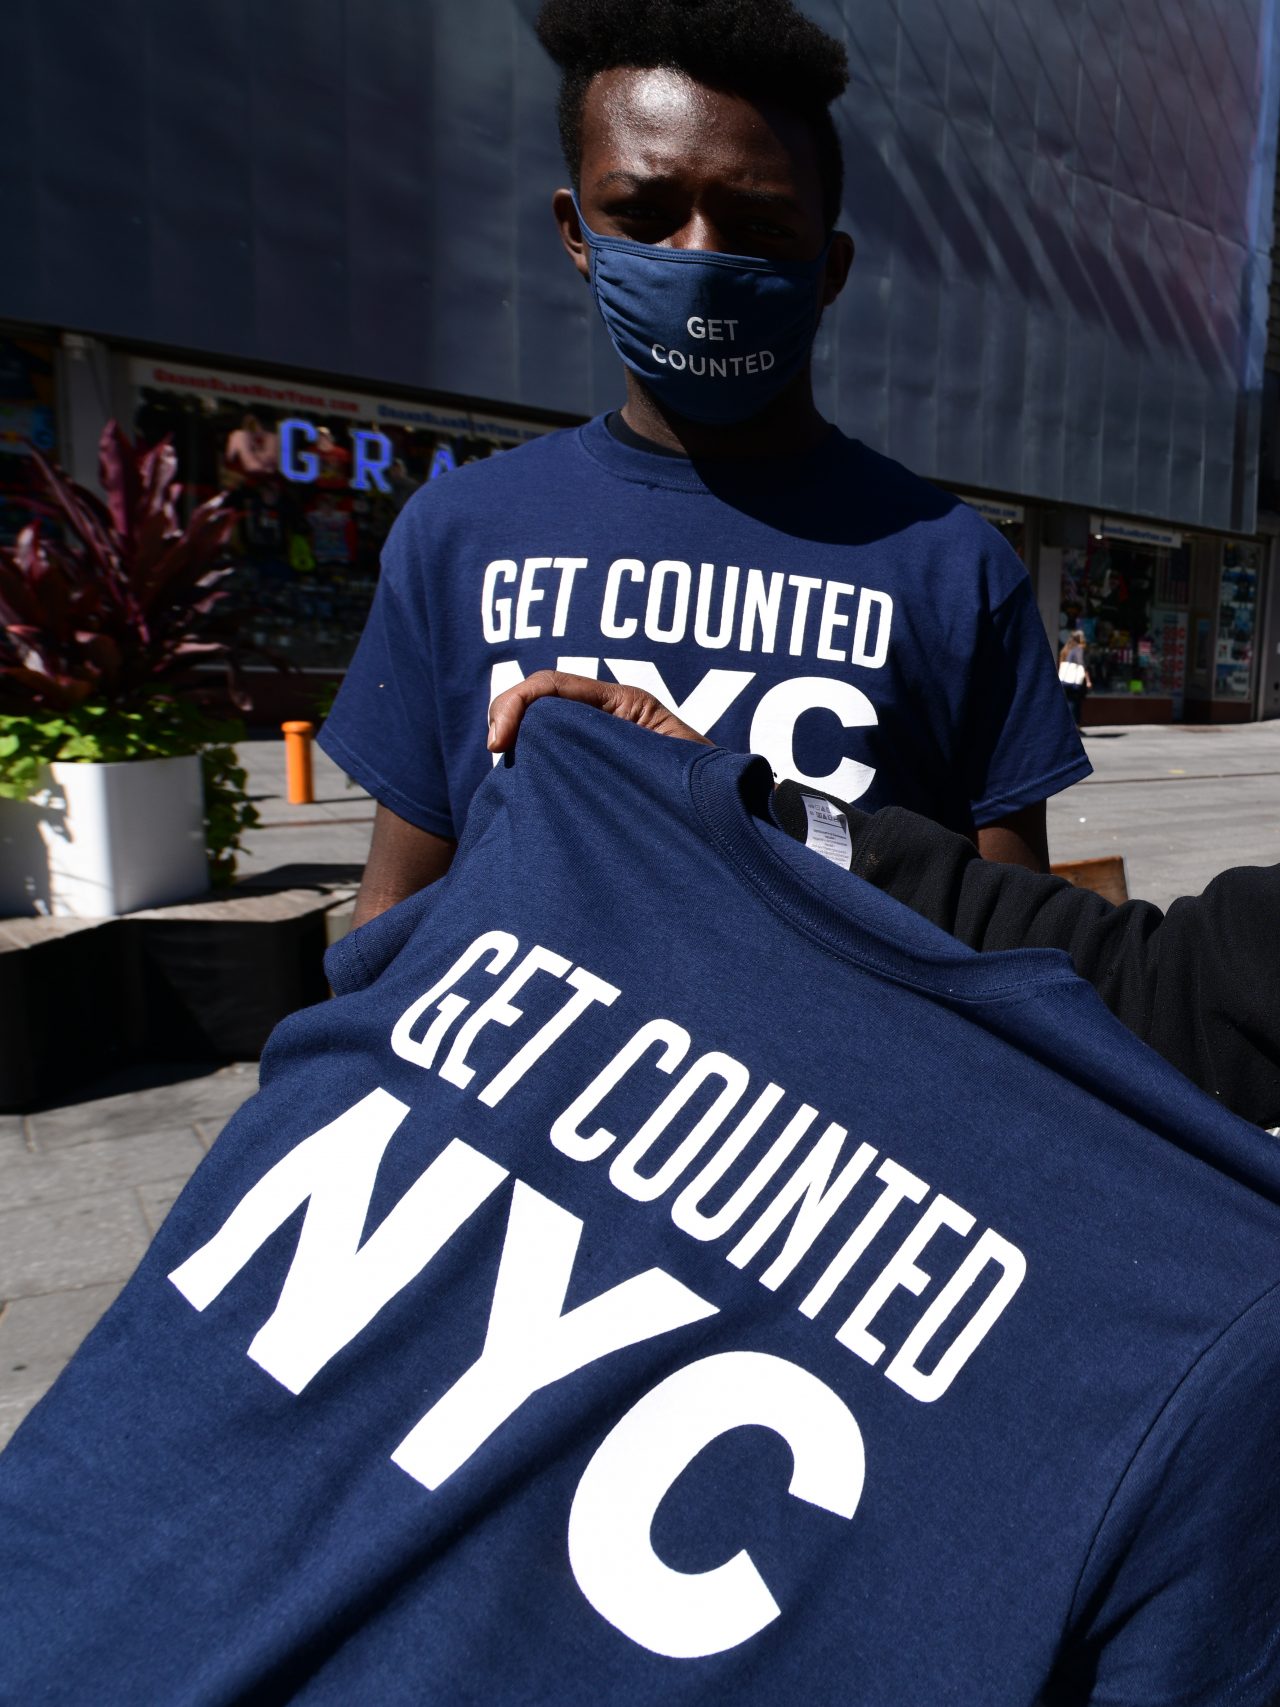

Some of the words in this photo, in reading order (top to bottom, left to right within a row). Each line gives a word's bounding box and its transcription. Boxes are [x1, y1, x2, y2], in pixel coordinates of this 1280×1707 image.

[651, 343, 775, 378] COUNTED
[686, 316, 739, 341] GET
[279, 418, 457, 493] GRA
[480, 557, 589, 644] GET
[600, 558, 895, 669] COUNTED
[390, 930, 622, 1109] GET
[549, 1018, 1028, 1403] COUNTED
[167, 1085, 867, 1659] NYC
